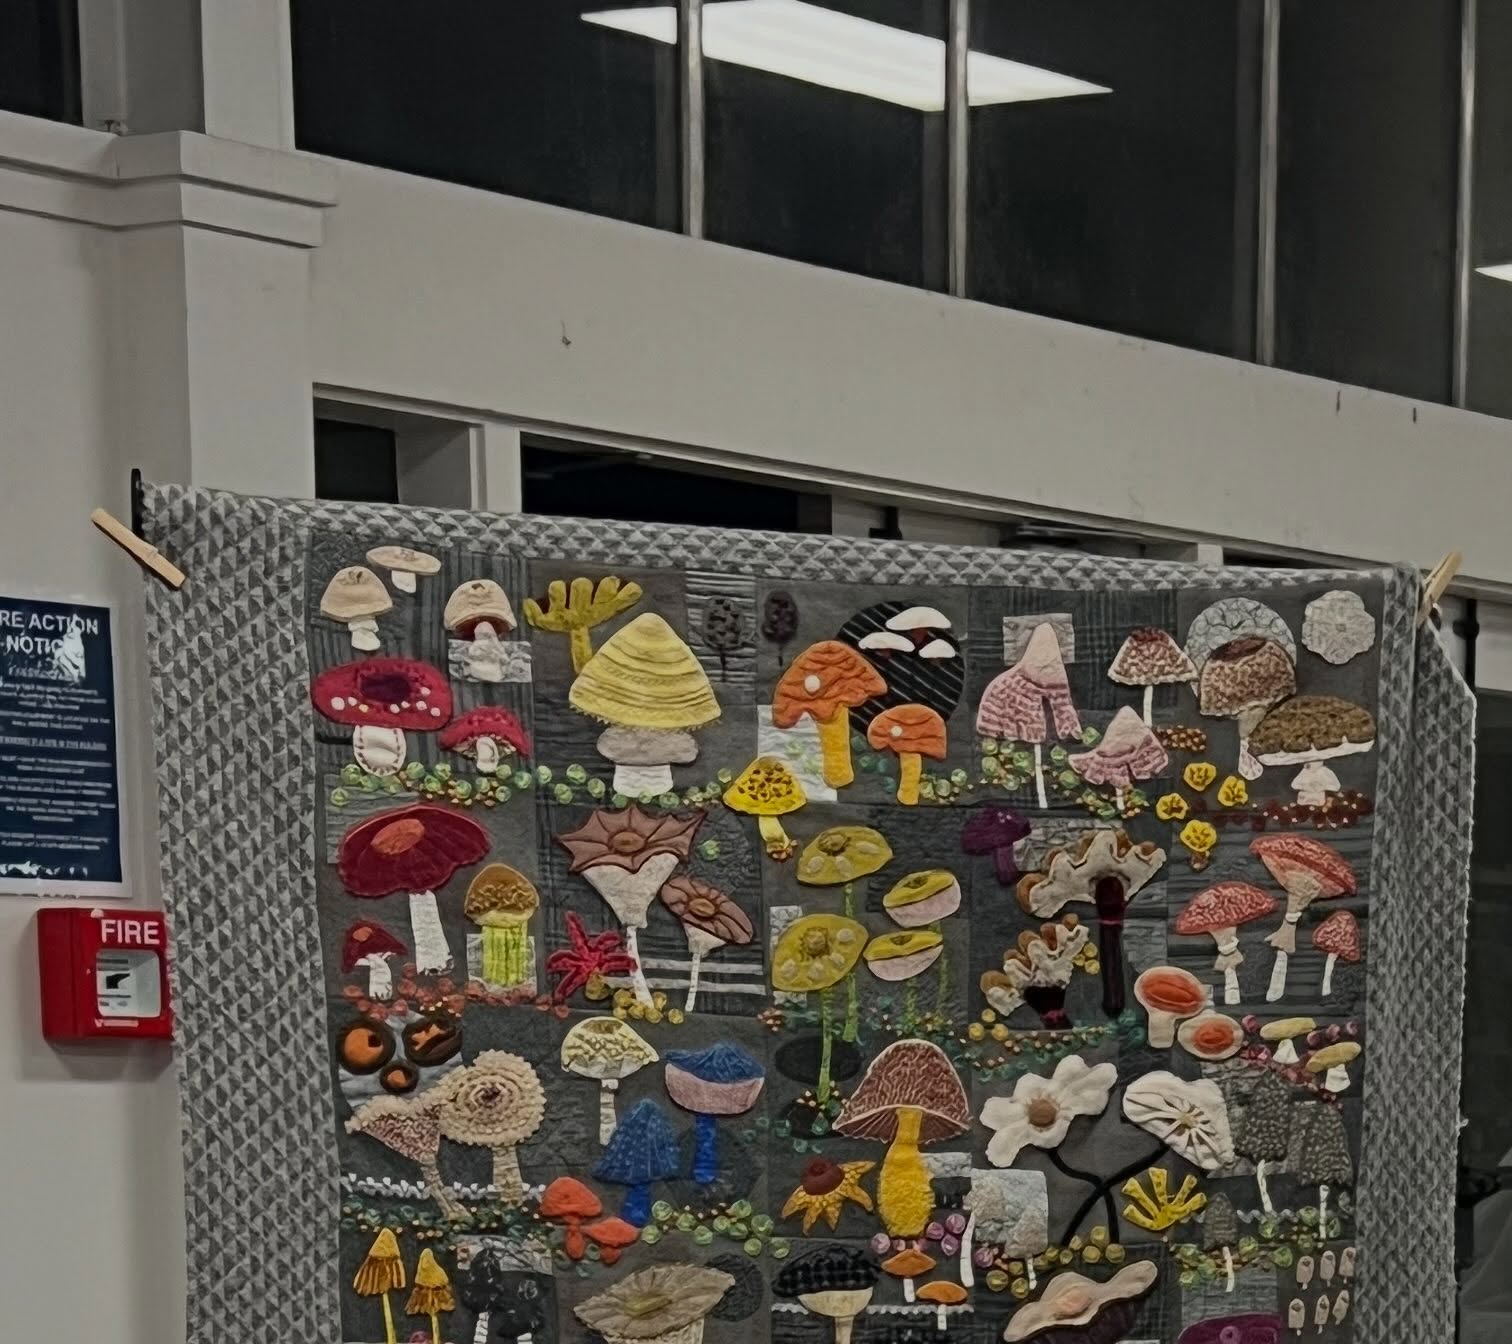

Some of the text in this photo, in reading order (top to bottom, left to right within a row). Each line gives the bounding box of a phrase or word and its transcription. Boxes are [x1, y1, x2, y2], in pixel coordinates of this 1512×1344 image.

[28, 613, 99, 635] ACTION
[6, 634, 65, 655] NOTIC
[101, 919, 160, 945] FIRE
